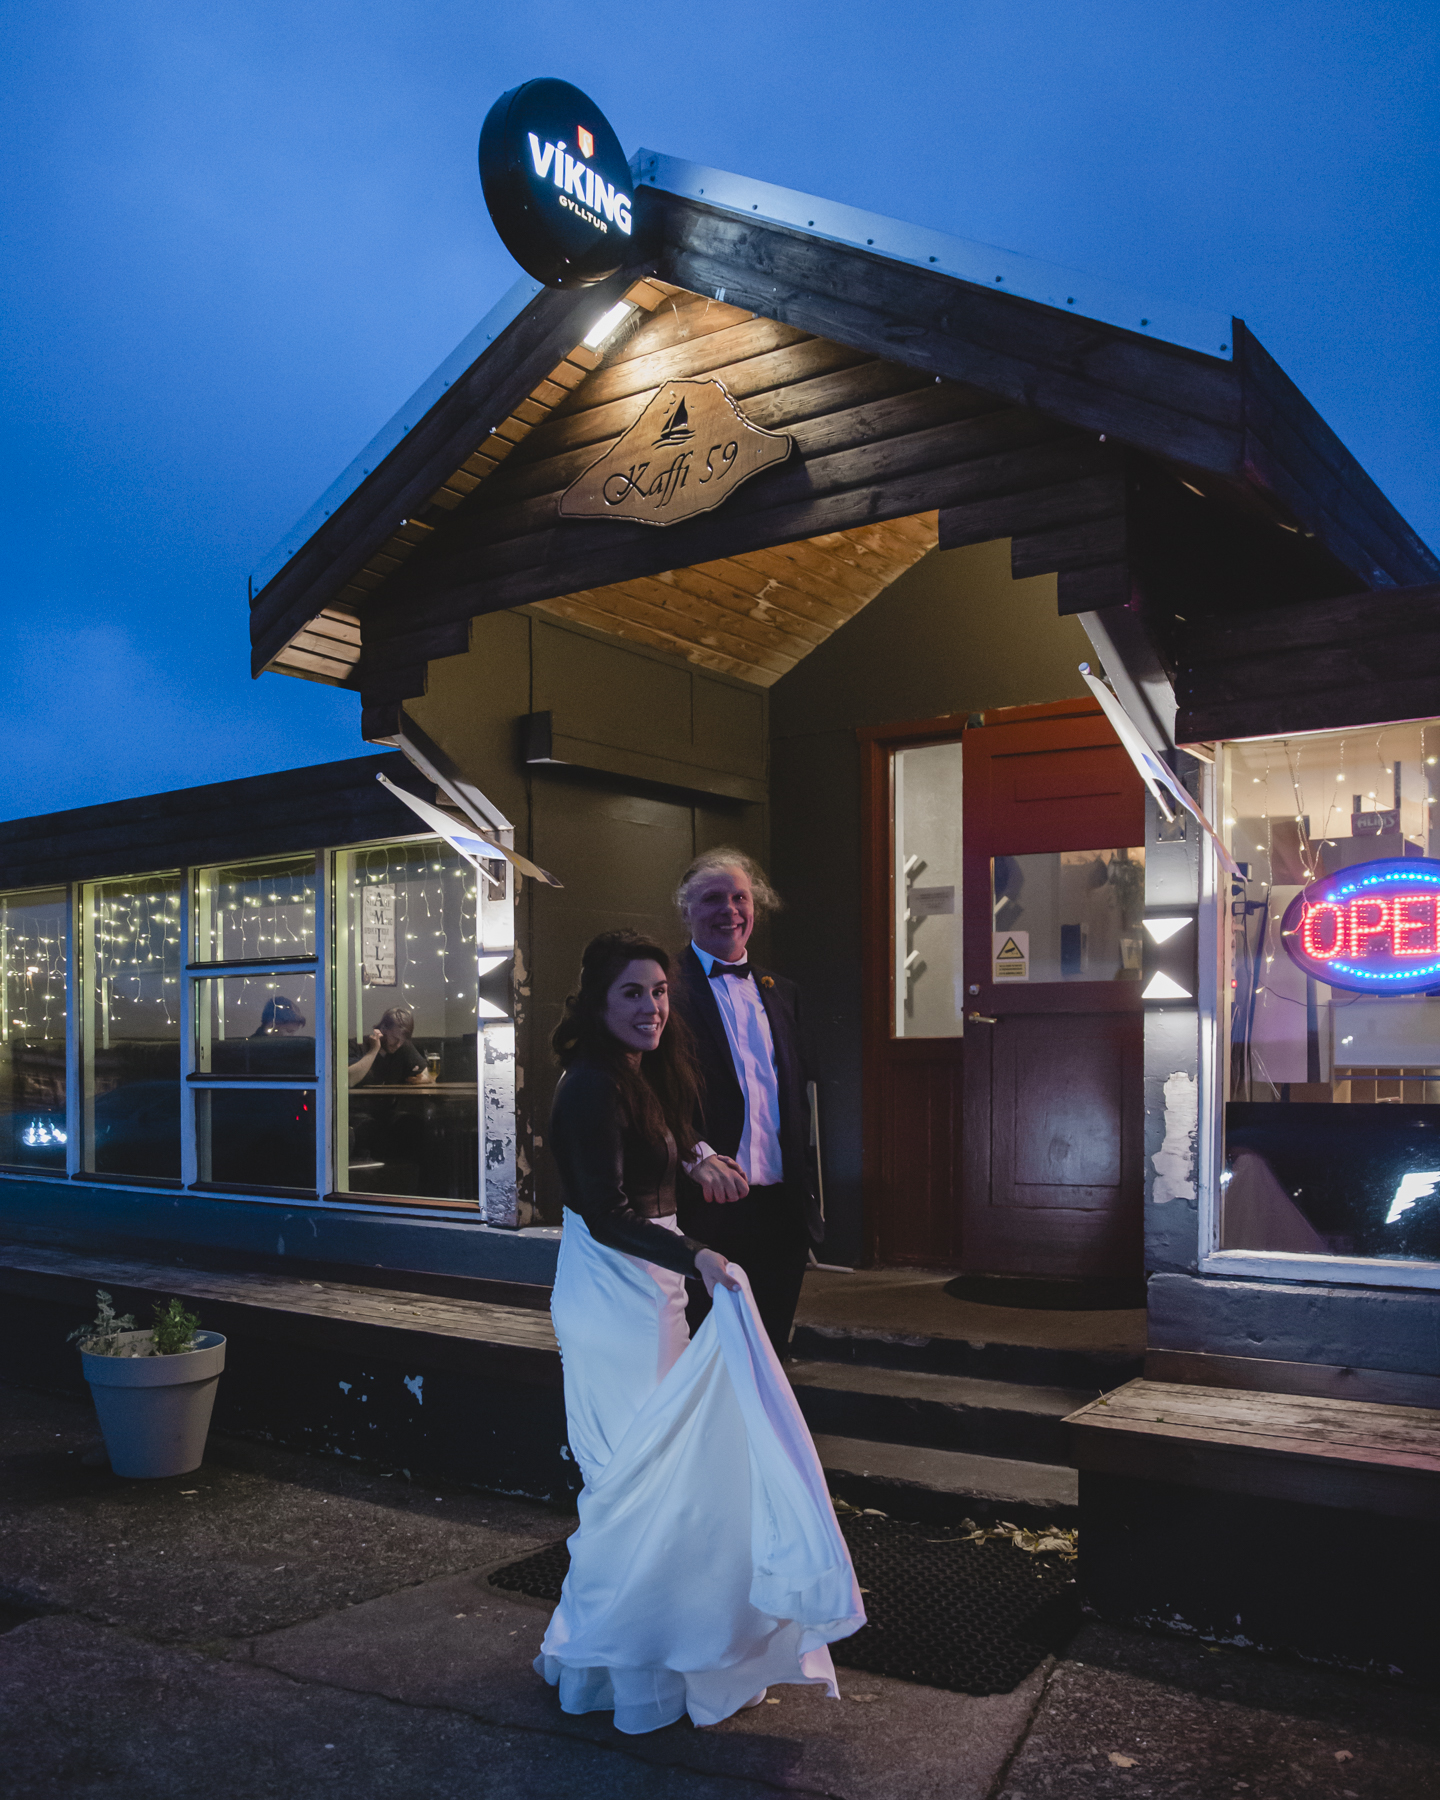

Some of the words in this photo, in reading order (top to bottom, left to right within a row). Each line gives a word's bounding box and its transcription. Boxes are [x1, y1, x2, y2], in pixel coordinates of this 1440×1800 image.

[558, 194, 608, 234] GYLLTUR
[603, 450, 694, 510] Kaffi
[699, 440, 739, 485] 59
[1303, 896, 1440, 958] OPE
